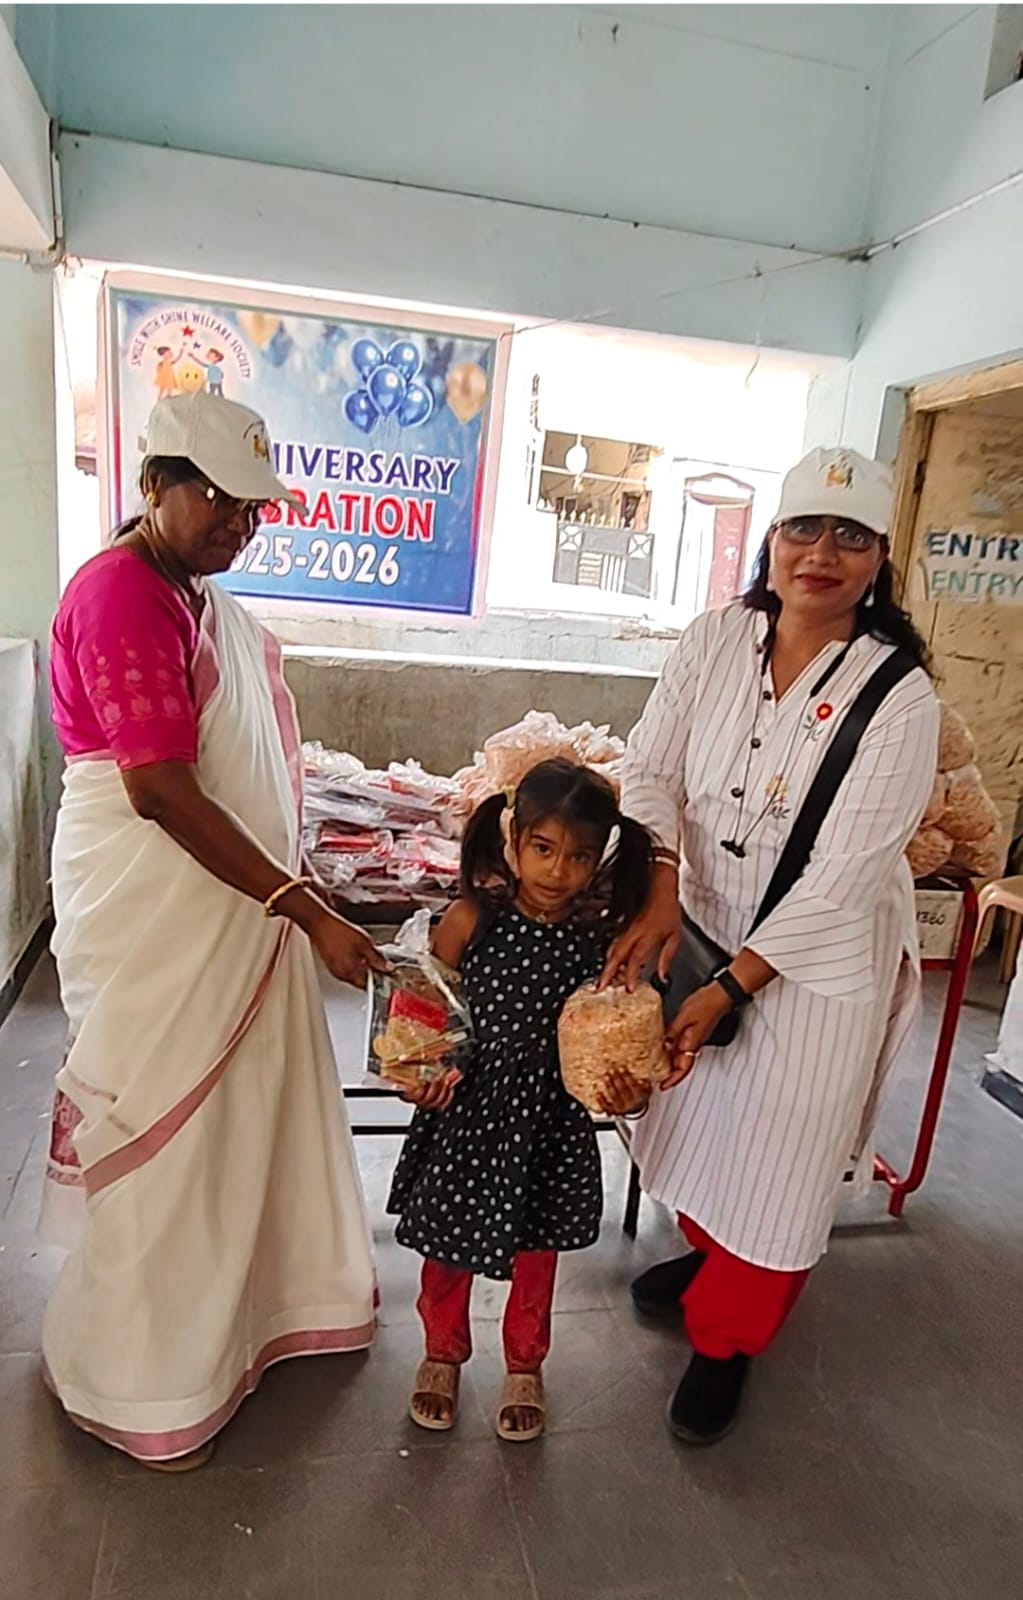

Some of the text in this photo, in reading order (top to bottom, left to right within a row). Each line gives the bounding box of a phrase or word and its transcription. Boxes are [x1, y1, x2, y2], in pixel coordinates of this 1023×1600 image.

[130, 311, 252, 379] SMILE WITH SHINE WELFARE SOCIETY
[926, 531, 1023, 561] ENTR
